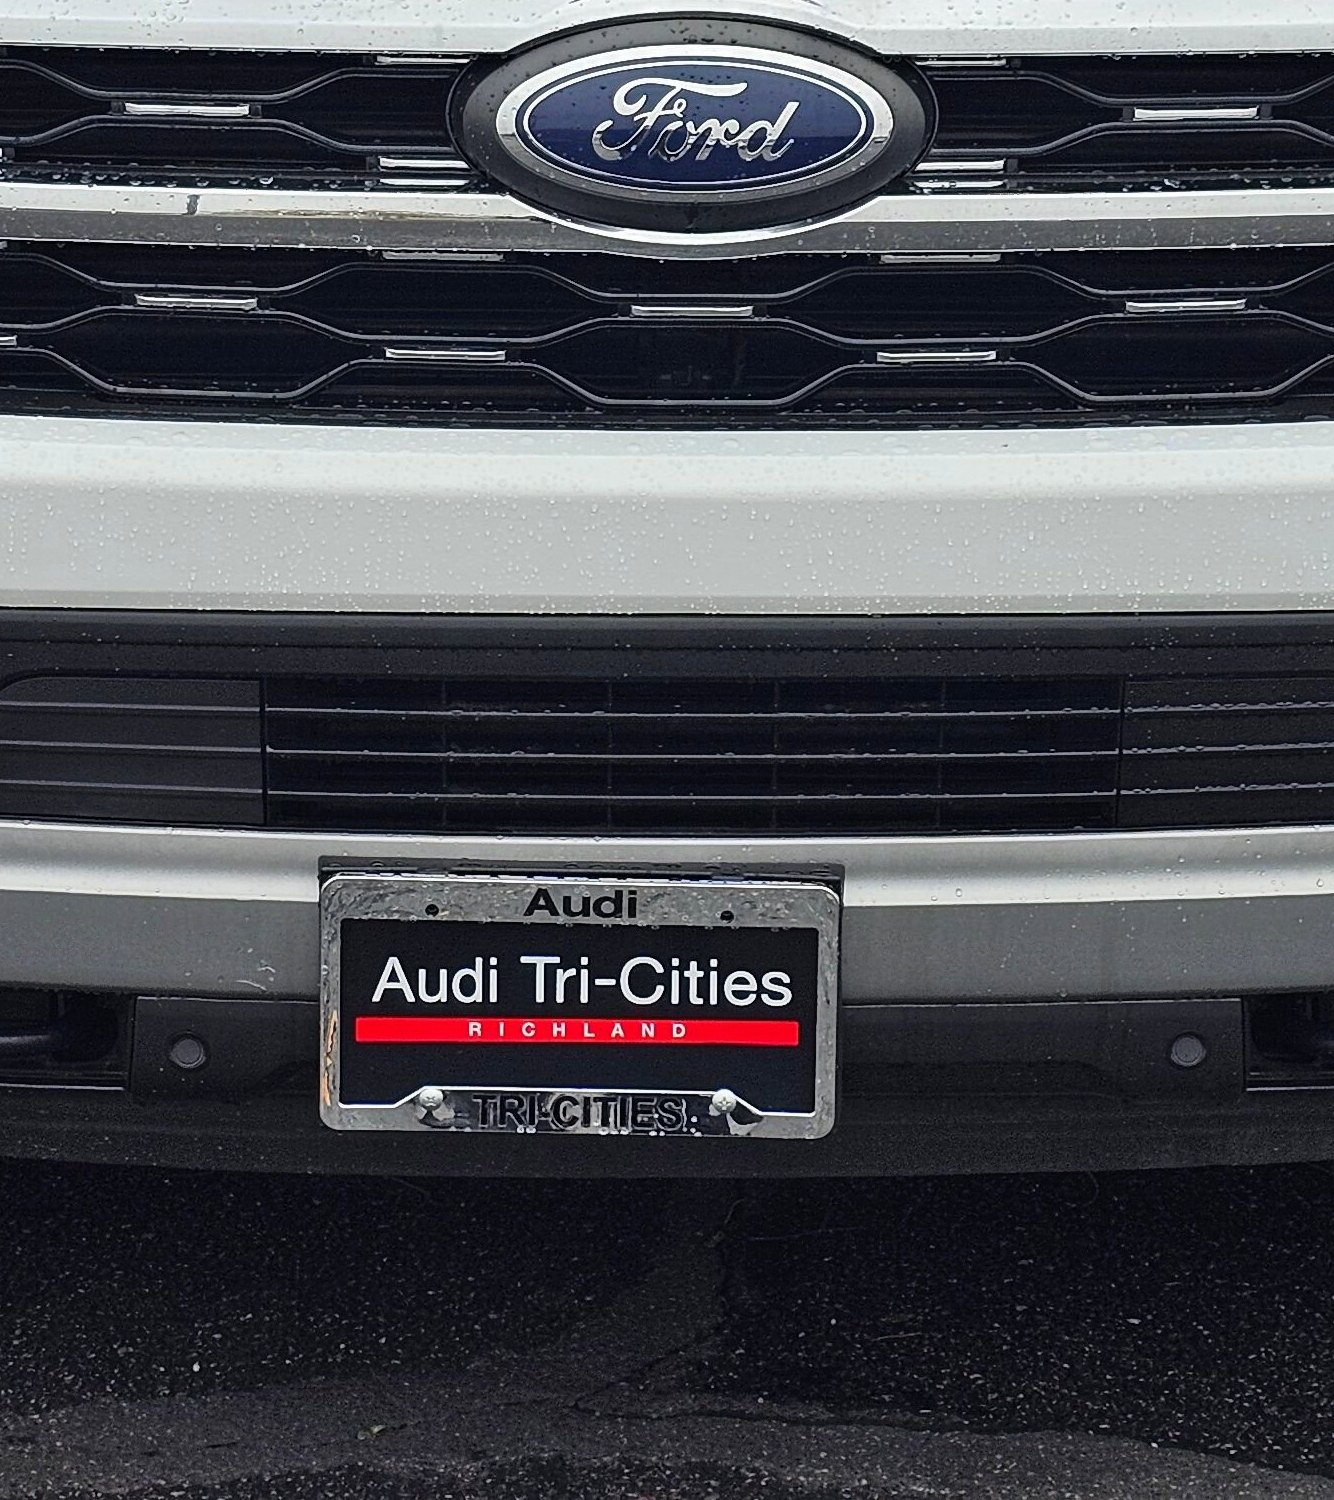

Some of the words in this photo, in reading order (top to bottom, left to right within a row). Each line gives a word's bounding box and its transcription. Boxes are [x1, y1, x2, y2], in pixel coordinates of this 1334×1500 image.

[591, 77, 801, 162] Ford
[523, 888, 638, 919] Audi
[371, 956, 498, 1005] Audi
[520, 955, 793, 1007] Tri-Cities
[468, 1020, 687, 1039] RICHLAND
[472, 1093, 689, 1132] TRI-CITIES
